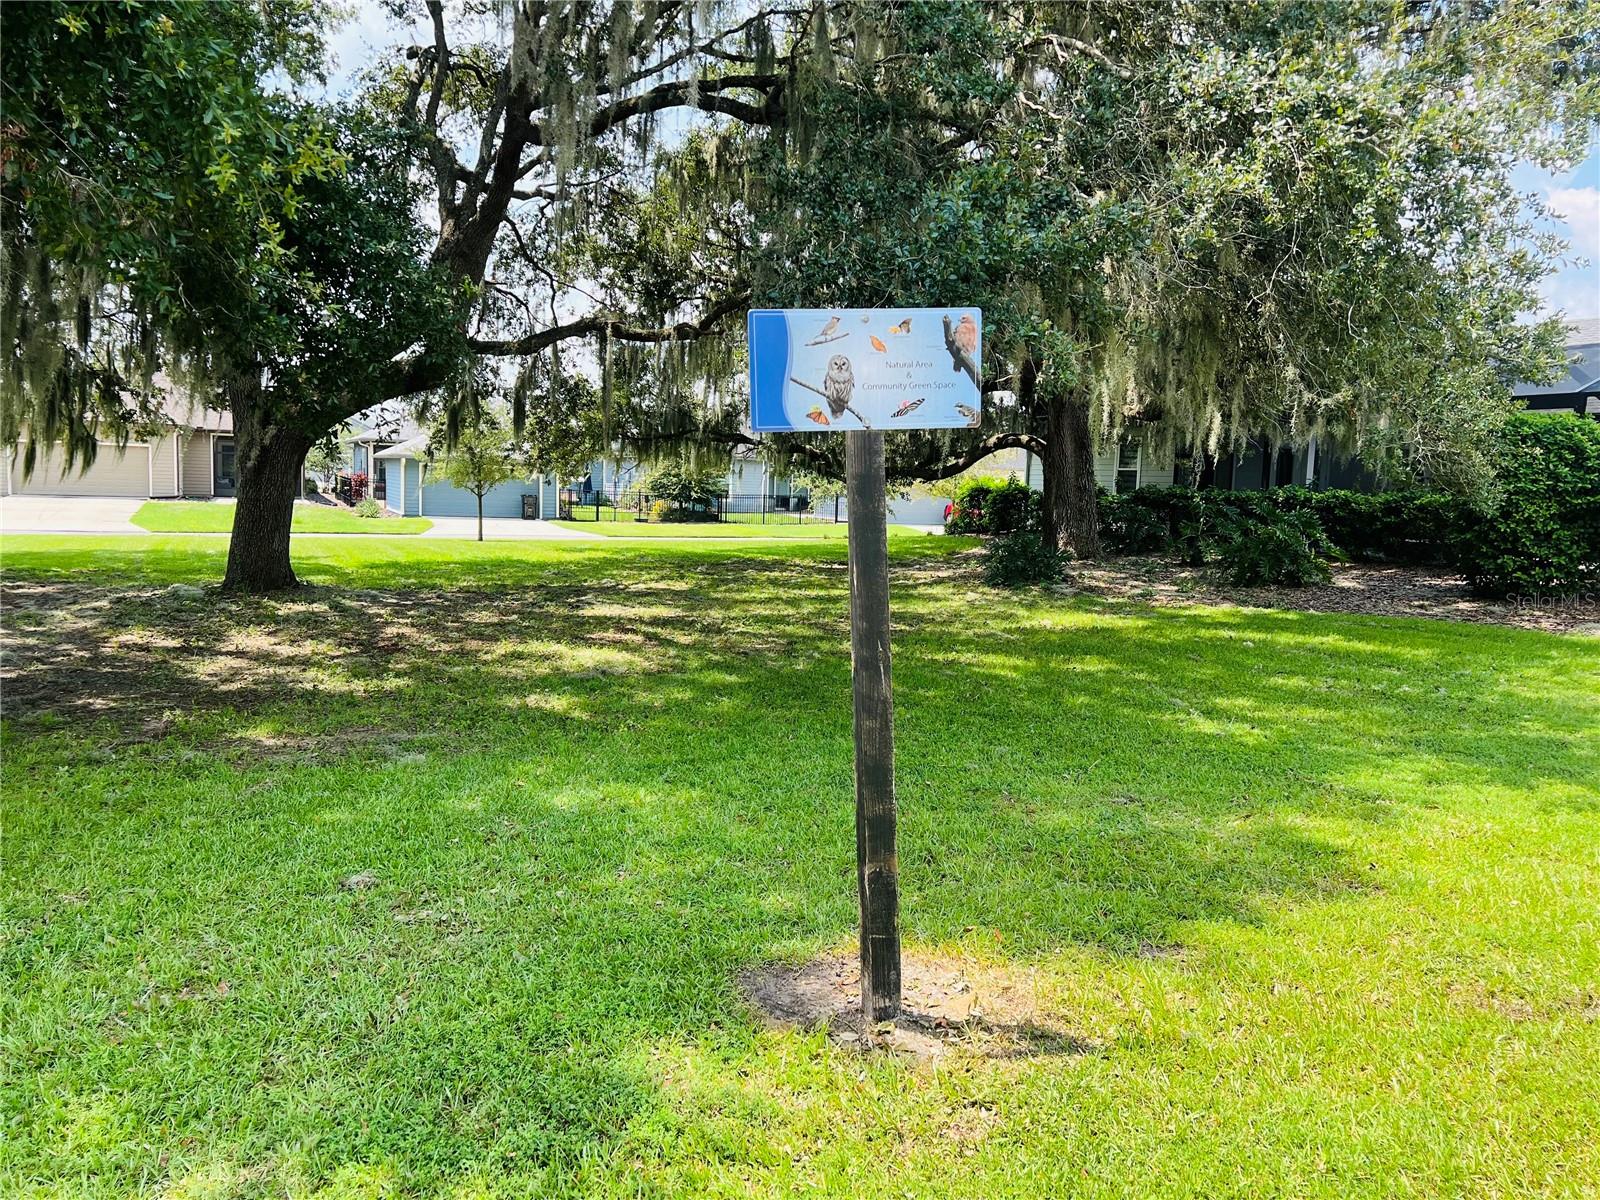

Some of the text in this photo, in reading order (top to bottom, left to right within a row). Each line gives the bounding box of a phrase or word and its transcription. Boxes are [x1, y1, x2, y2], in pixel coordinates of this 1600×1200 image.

[885, 360, 933, 369] Natural Area
[906, 371, 912, 379] &
[862, 381, 956, 391] Community Green Space
